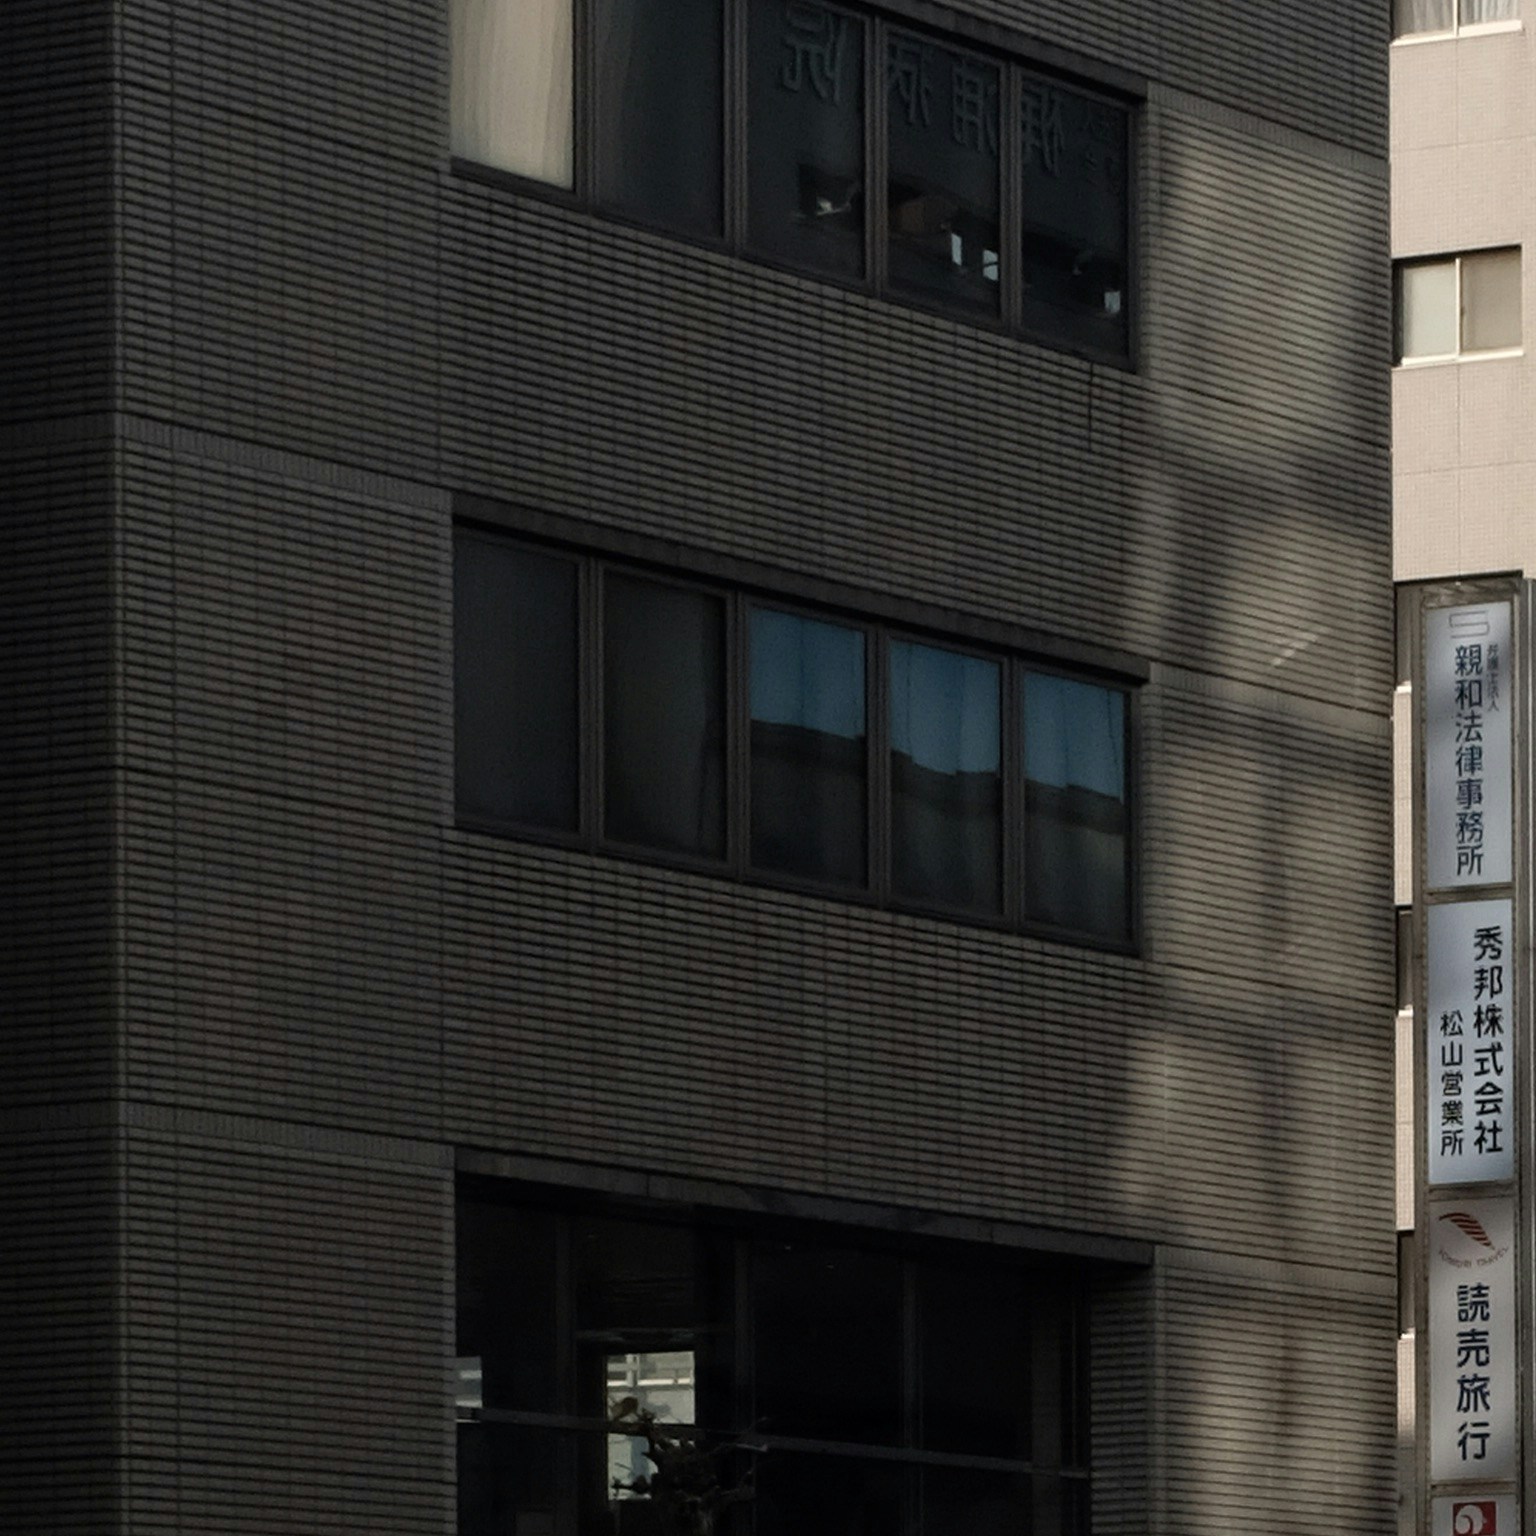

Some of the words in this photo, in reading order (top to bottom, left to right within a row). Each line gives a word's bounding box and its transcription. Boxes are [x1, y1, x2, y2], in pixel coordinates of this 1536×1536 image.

[1455, 645, 1483, 876] 親和法律事務所
[1440, 1010, 1463, 1156] 松山営業所
[1473, 926, 1503, 1154] 秀邦株式会社
[1457, 1282, 1490, 1461] 読売旅行
